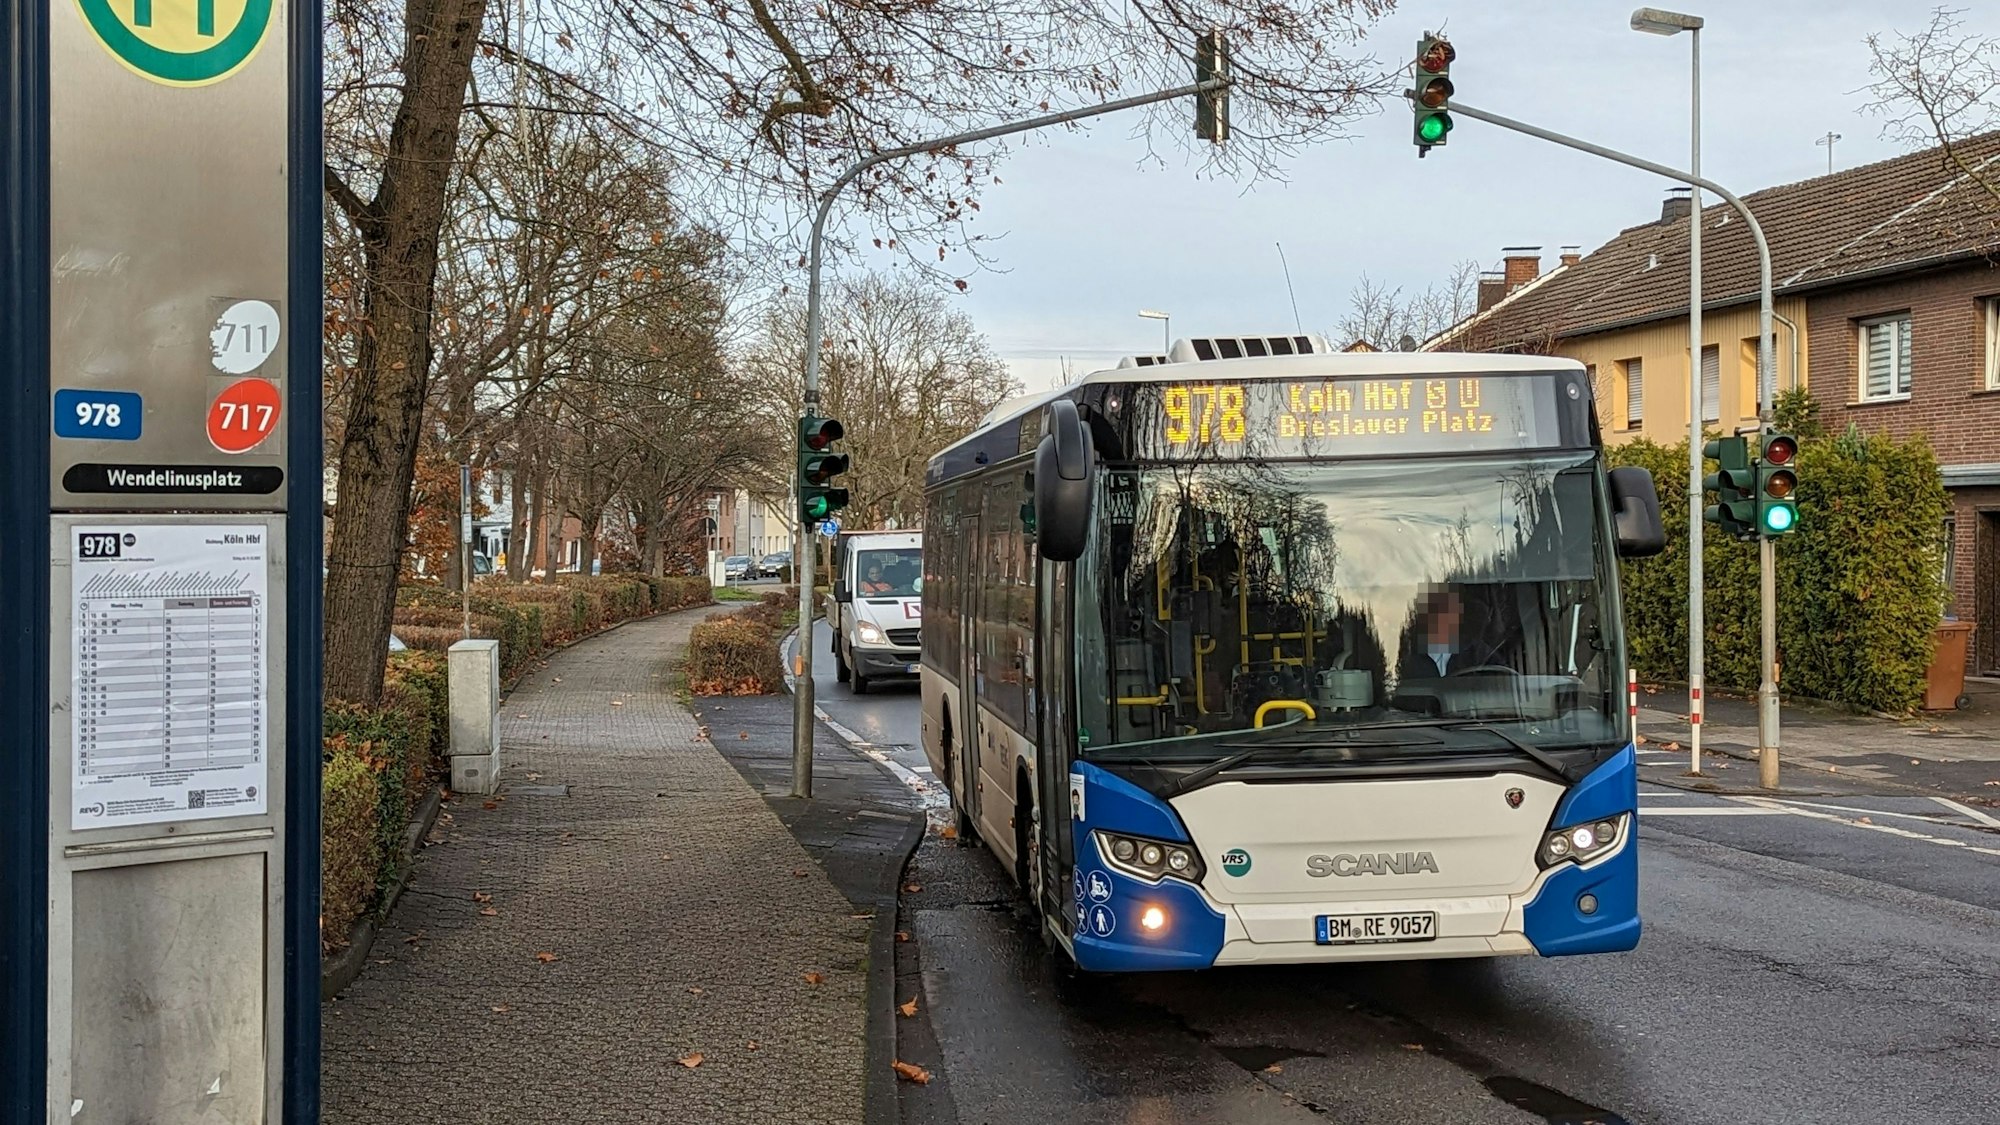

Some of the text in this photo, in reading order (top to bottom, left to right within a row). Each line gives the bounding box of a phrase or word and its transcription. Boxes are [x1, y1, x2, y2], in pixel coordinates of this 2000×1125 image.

[221, 323, 268, 353] 711
[76, 402, 121, 427] 978
[219, 403, 273, 431] 717
[1165, 385, 1244, 444] 978
[1363, 382, 1412, 410] Hbf
[1280, 410, 1493, 437] Breslauer Platz
[107, 469, 242, 490] Wendelinusplatz
[83, 536, 116, 555] 978
[224, 534, 243, 544] Köln
[246, 534, 260, 544] Hbf
[80, 806, 99, 814] REVG
[1221, 854, 1244, 864] VRS
[1306, 851, 1439, 878] SCANIA
[1330, 919, 1351, 937] BM
[1364, 918, 1385, 936] RE
[1390, 916, 1432, 935] 9057
